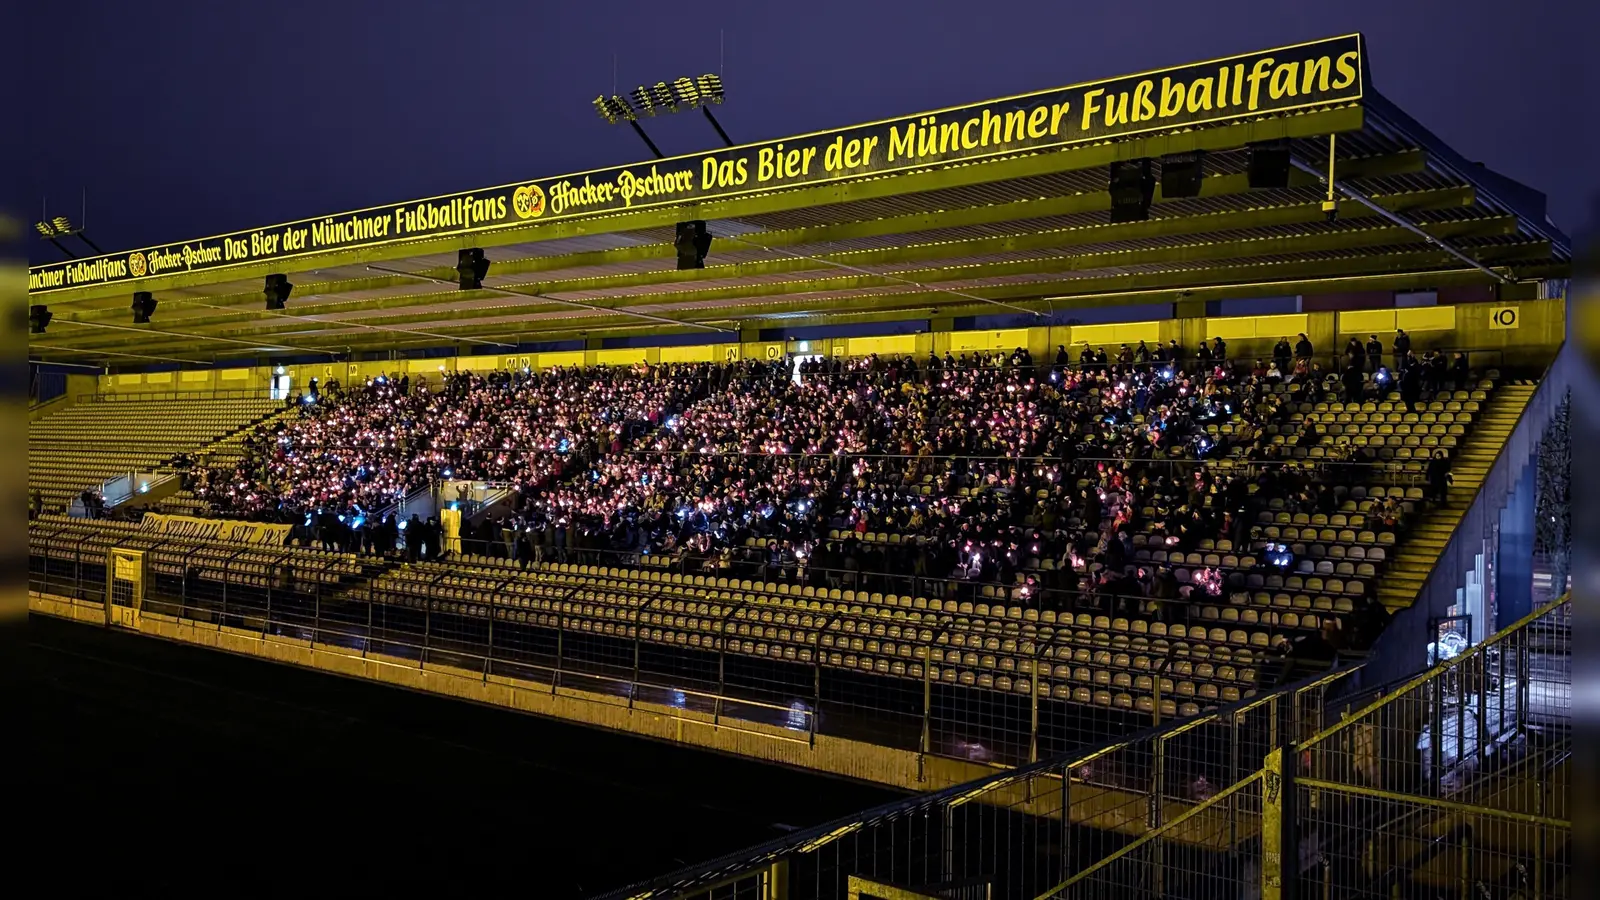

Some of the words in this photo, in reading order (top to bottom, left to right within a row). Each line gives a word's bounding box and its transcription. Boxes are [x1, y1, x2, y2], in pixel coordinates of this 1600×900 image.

[66, 258, 127, 285] Fußballfans
[147, 242, 222, 273] Hacker-Pschorr
[224, 237, 248, 260] Das
[251, 230, 279, 256] Bier
[282, 227, 308, 251] der
[311, 213, 392, 245] Münchner
[395, 195, 507, 234] Fußballfans
[549, 165, 694, 214] Hacker-Pschorr
[702, 156, 748, 190] Das
[757, 143, 817, 182] Bier
[824, 135, 878, 172] der
[887, 101, 1071, 162] Münchner
[1080, 50, 1359, 131] Fußballfans
[1499, 309, 1516, 326] O
[729, 347, 737, 359] N
